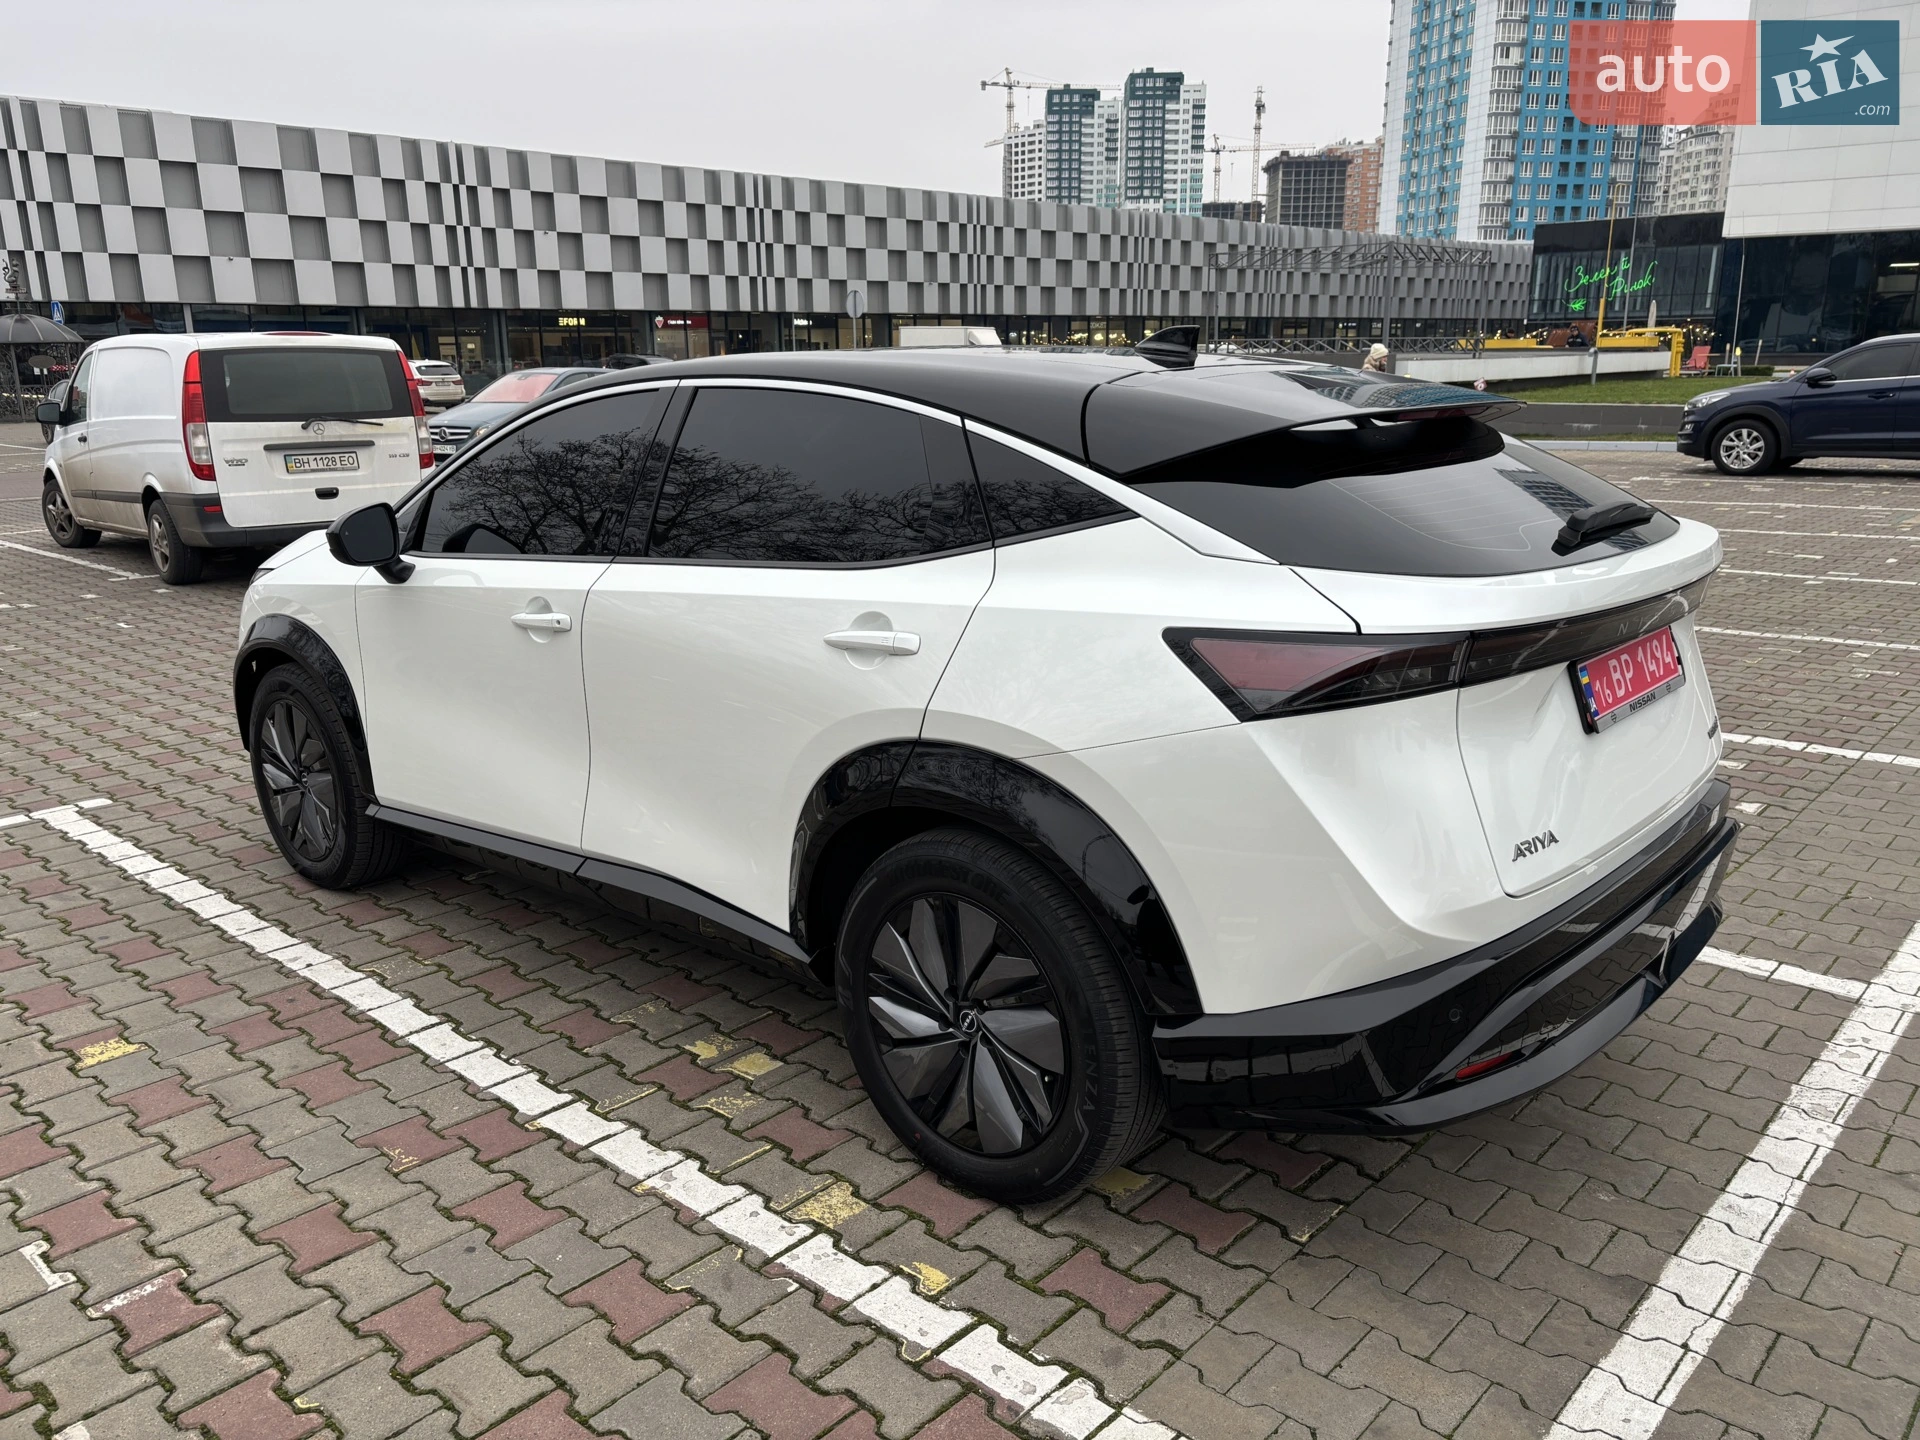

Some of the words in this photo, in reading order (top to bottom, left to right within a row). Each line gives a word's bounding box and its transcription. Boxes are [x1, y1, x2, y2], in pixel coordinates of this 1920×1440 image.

[293, 457, 311, 469] BH
[312, 456, 338, 467] 1128
[339, 454, 355, 466] EO
[1595, 676, 1613, 708] 16
[1608, 653, 1634, 698] BP
[1637, 634, 1675, 683] 1494
[1628, 691, 1657, 713] NISSAN
[1511, 829, 1560, 863] ARIYA
